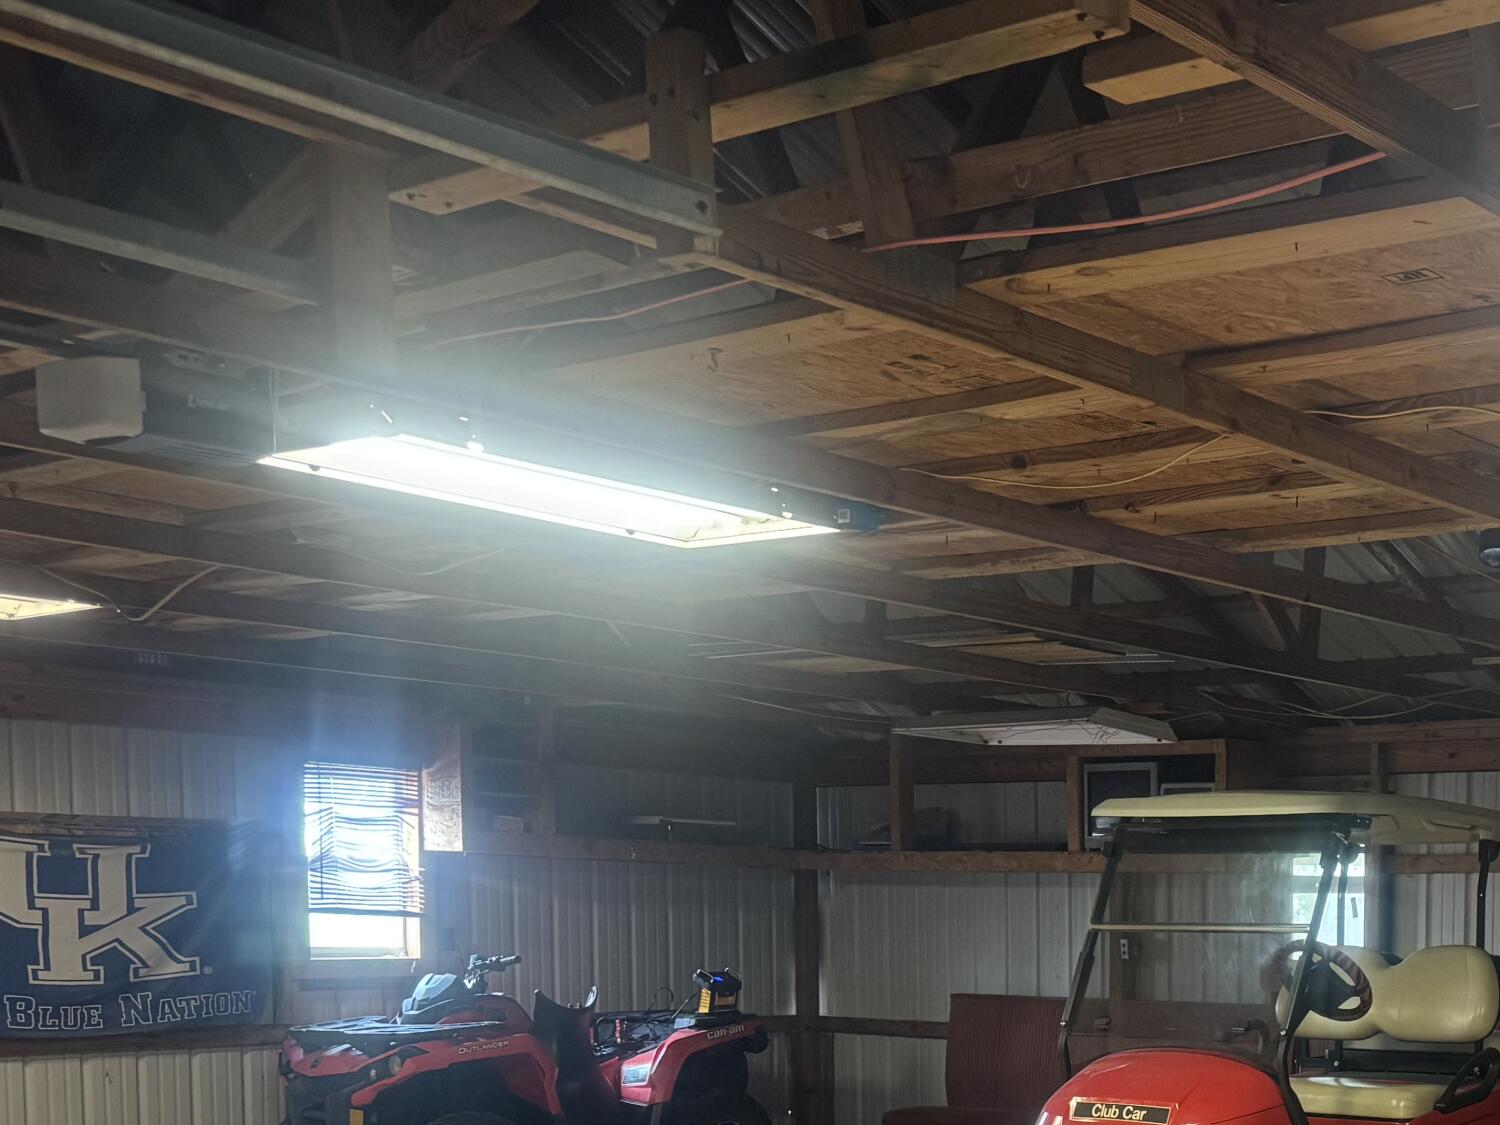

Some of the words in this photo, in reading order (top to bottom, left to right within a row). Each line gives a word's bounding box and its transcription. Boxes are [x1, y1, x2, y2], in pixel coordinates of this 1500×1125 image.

[0, 835, 200, 985] UK
[4, 994, 104, 1030] BLUE
[118, 990, 252, 1028] NATION
[1091, 1103, 1119, 1118] Club
[1122, 1105, 1147, 1121] Car
